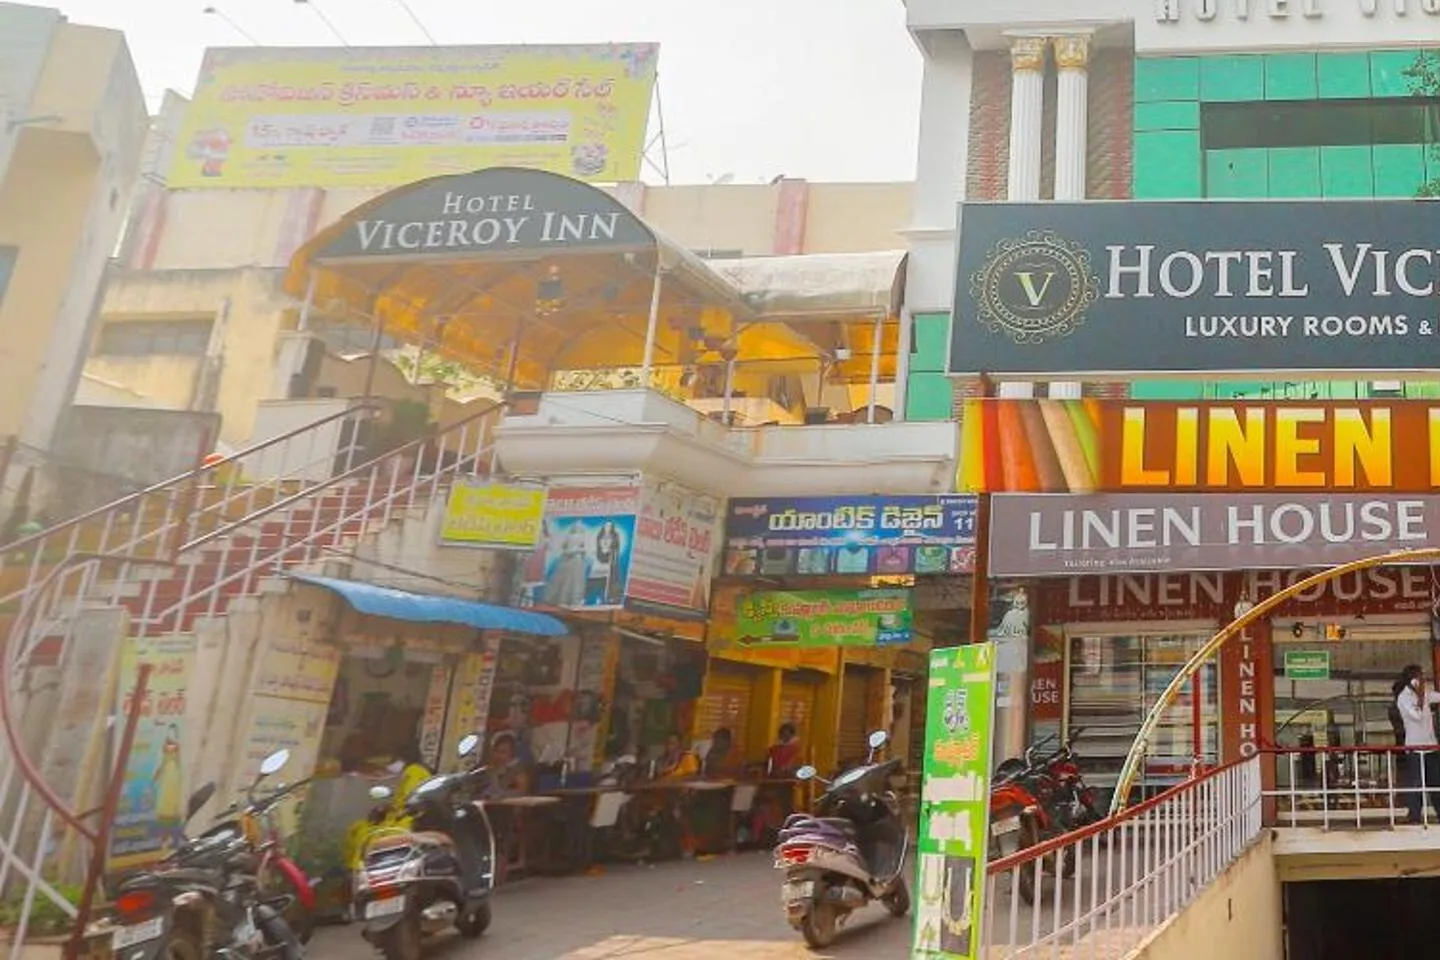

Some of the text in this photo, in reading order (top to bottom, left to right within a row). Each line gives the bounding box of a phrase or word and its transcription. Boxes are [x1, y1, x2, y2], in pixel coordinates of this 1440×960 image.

[441, 191, 536, 215] HOTEL
[355, 211, 621, 251] VICEROY INN
[1014, 271, 1056, 306] V
[1104, 243, 1309, 299] HOTEL
[1184, 315, 1295, 337] LUXURY
[1303, 314, 1409, 336] ROOMS
[1418, 318, 1433, 335] &
[1121, 407, 1392, 487] LINEN
[1029, 501, 1428, 550] LINEN HOUSE
[1068, 566, 1430, 607] LINEN HOUSE
[1239, 628, 1256, 714] LINEN
